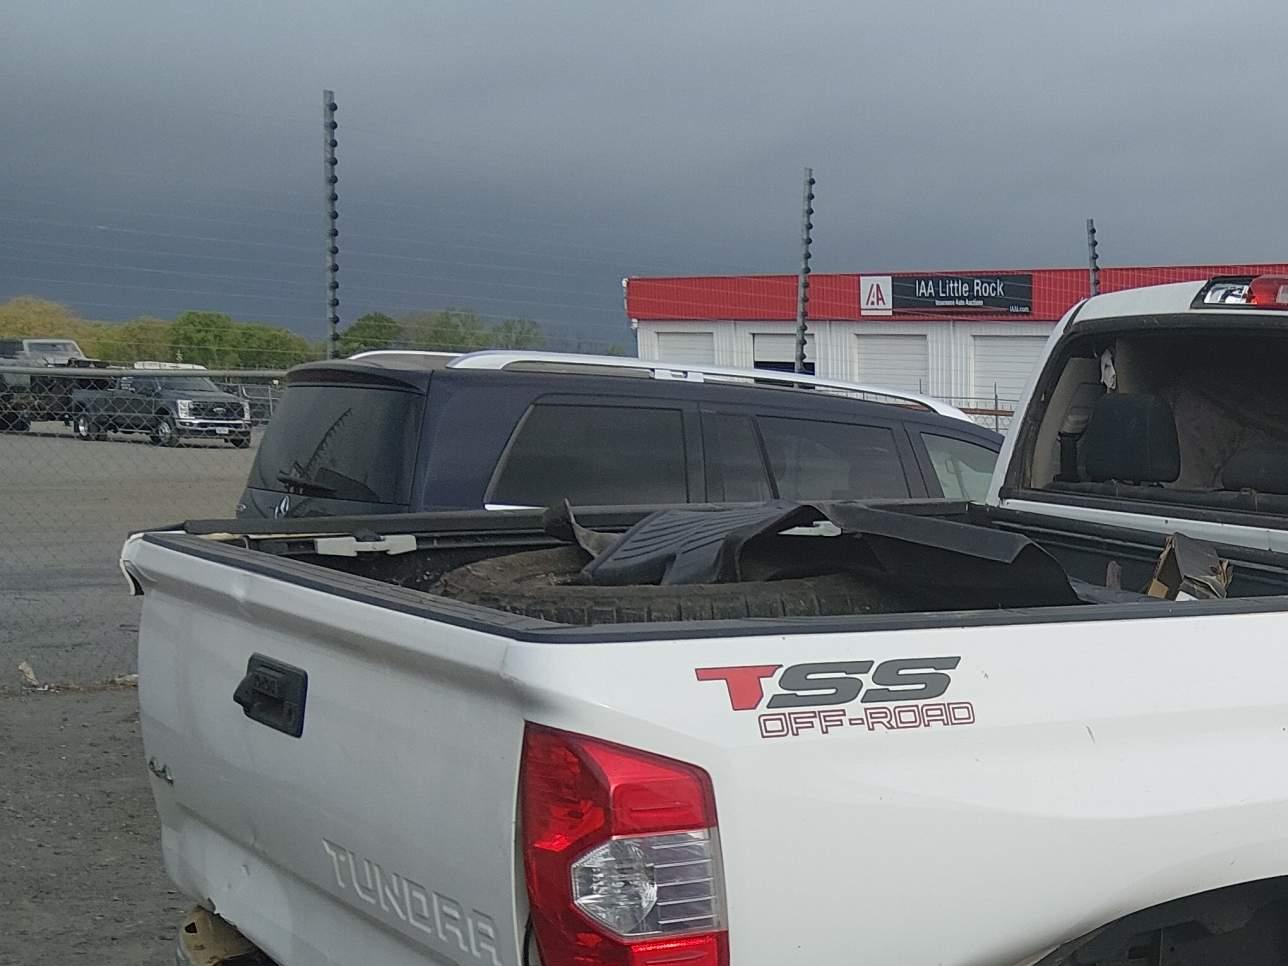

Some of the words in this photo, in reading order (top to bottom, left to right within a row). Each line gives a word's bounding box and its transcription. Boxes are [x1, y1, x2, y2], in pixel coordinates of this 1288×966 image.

[915, 279, 935, 297] IAA
[939, 279, 969, 297] Little
[974, 279, 1005, 297] Rock
[694, 655, 962, 711] TSS
[757, 701, 976, 739] OFF-ROAD
